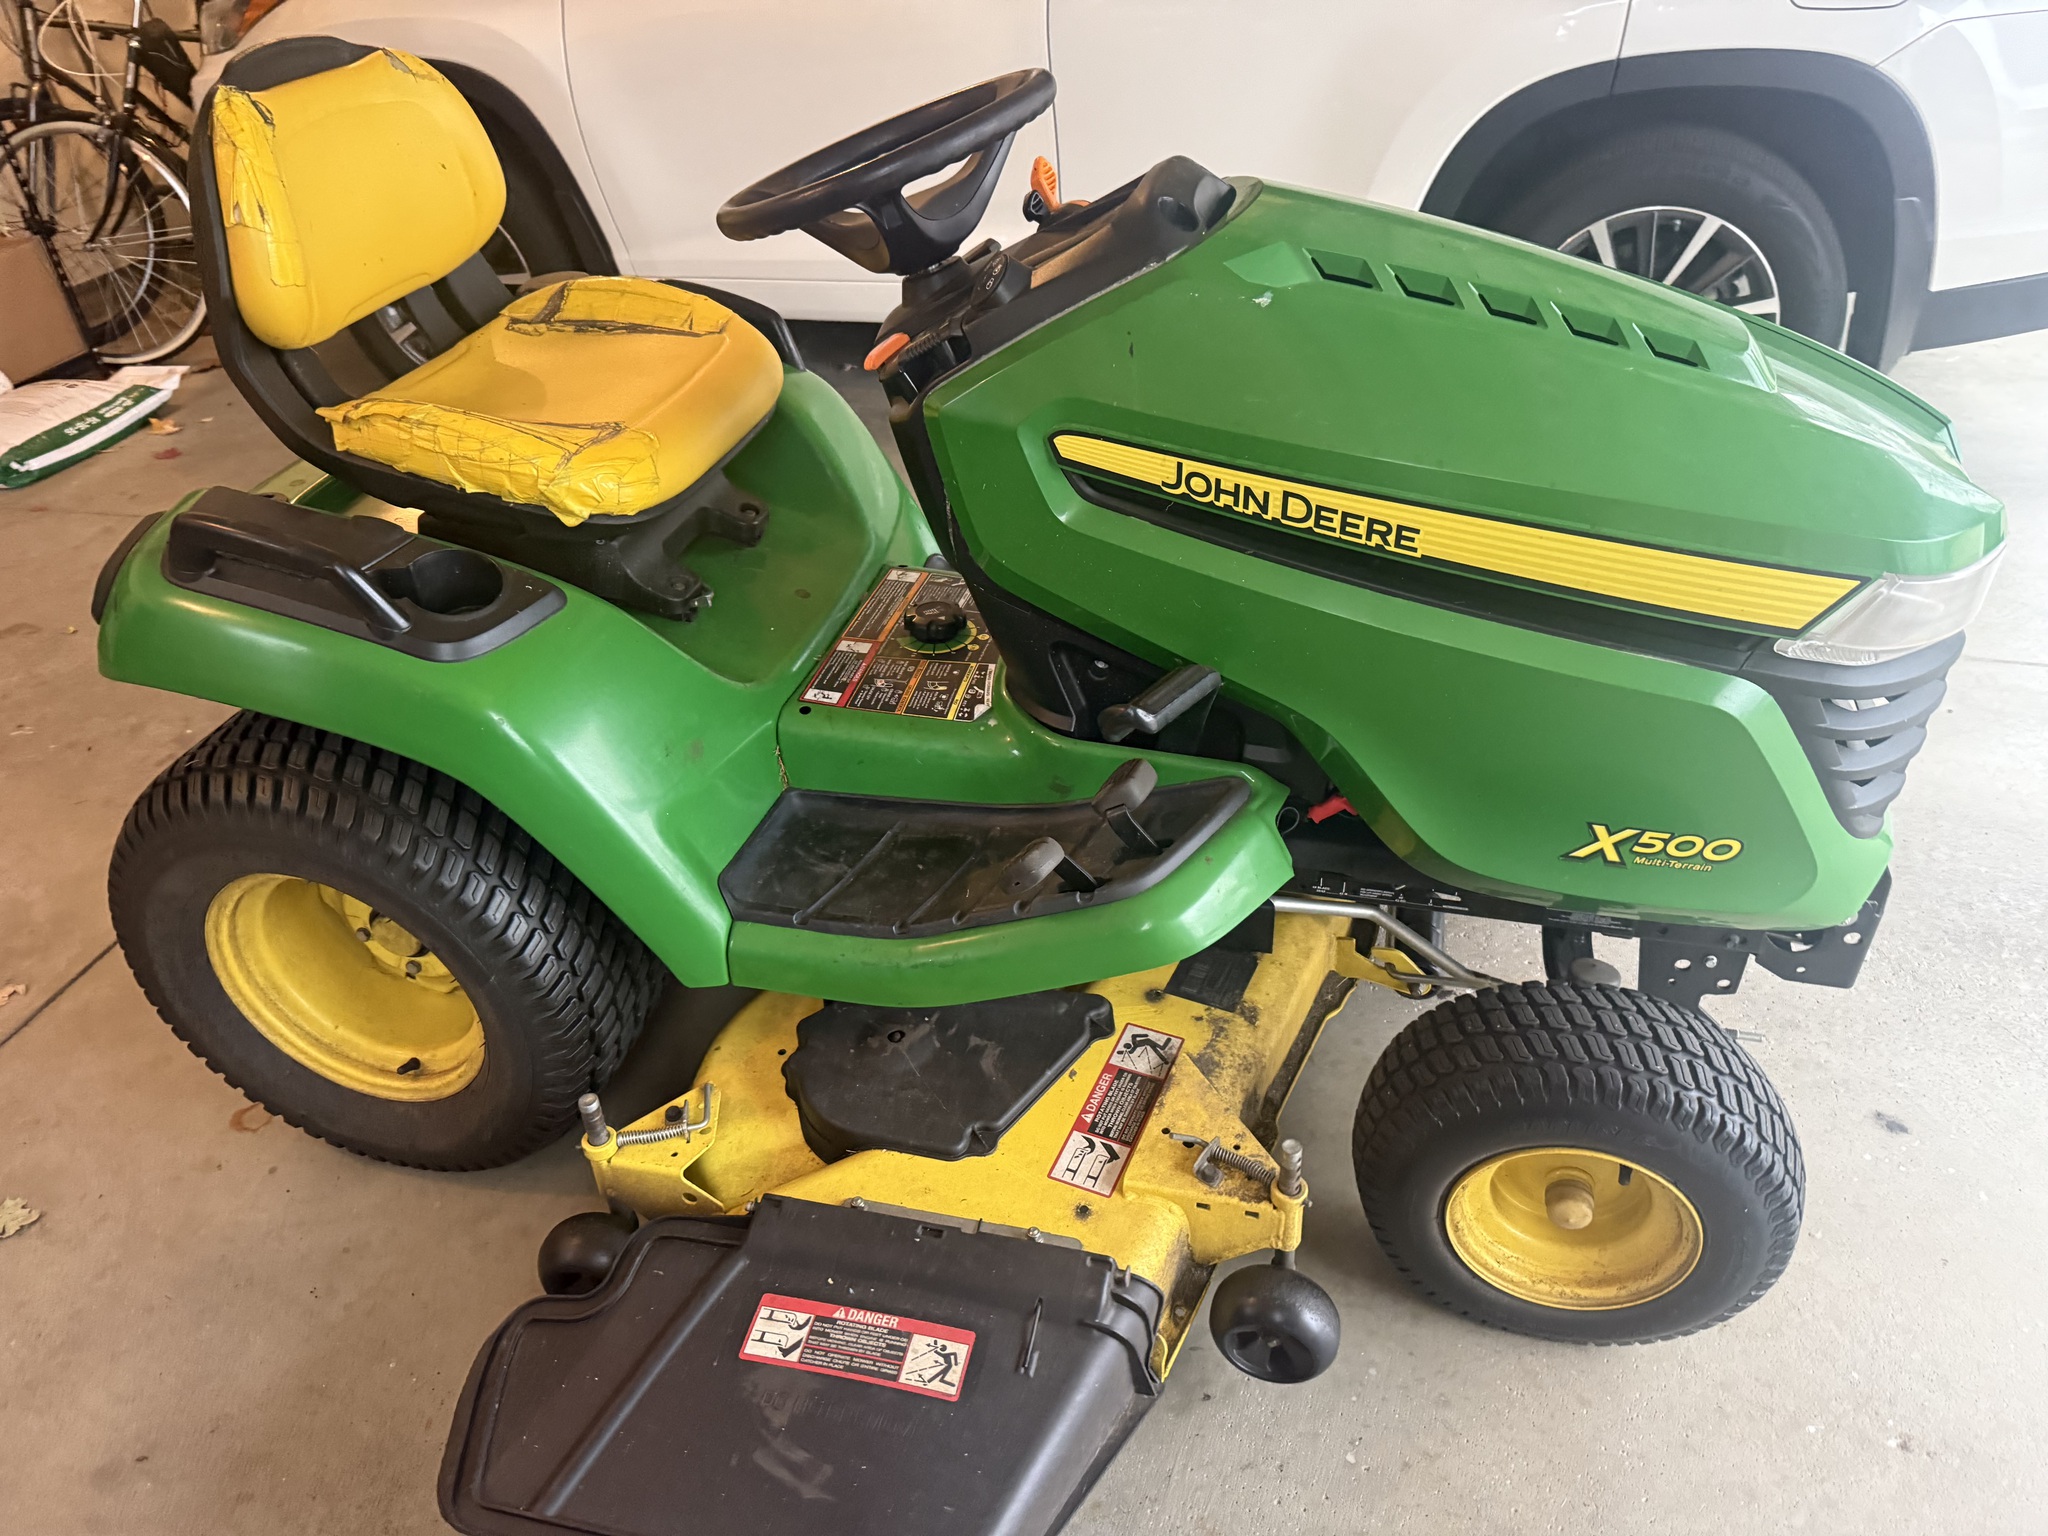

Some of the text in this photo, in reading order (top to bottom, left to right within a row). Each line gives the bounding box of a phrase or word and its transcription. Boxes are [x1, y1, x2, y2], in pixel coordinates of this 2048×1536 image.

[1161, 461, 1422, 554] JOHN DEERE
[1563, 822, 1743, 866] X500
[1633, 856, 1713, 872] Multi-Terrain
[1085, 1072, 1113, 1113] DANGER
[1094, 1079, 1118, 1122] ROTATING BLADE
[1107, 1105, 1122, 1128] THROWN
[1119, 1082, 1133, 1105] OBJECTS
[836, 1320, 888, 1333] ROTATING BLADE
[847, 1308, 899, 1327] DANGER
[829, 1333, 886, 1347] THROWN OBJECTS
